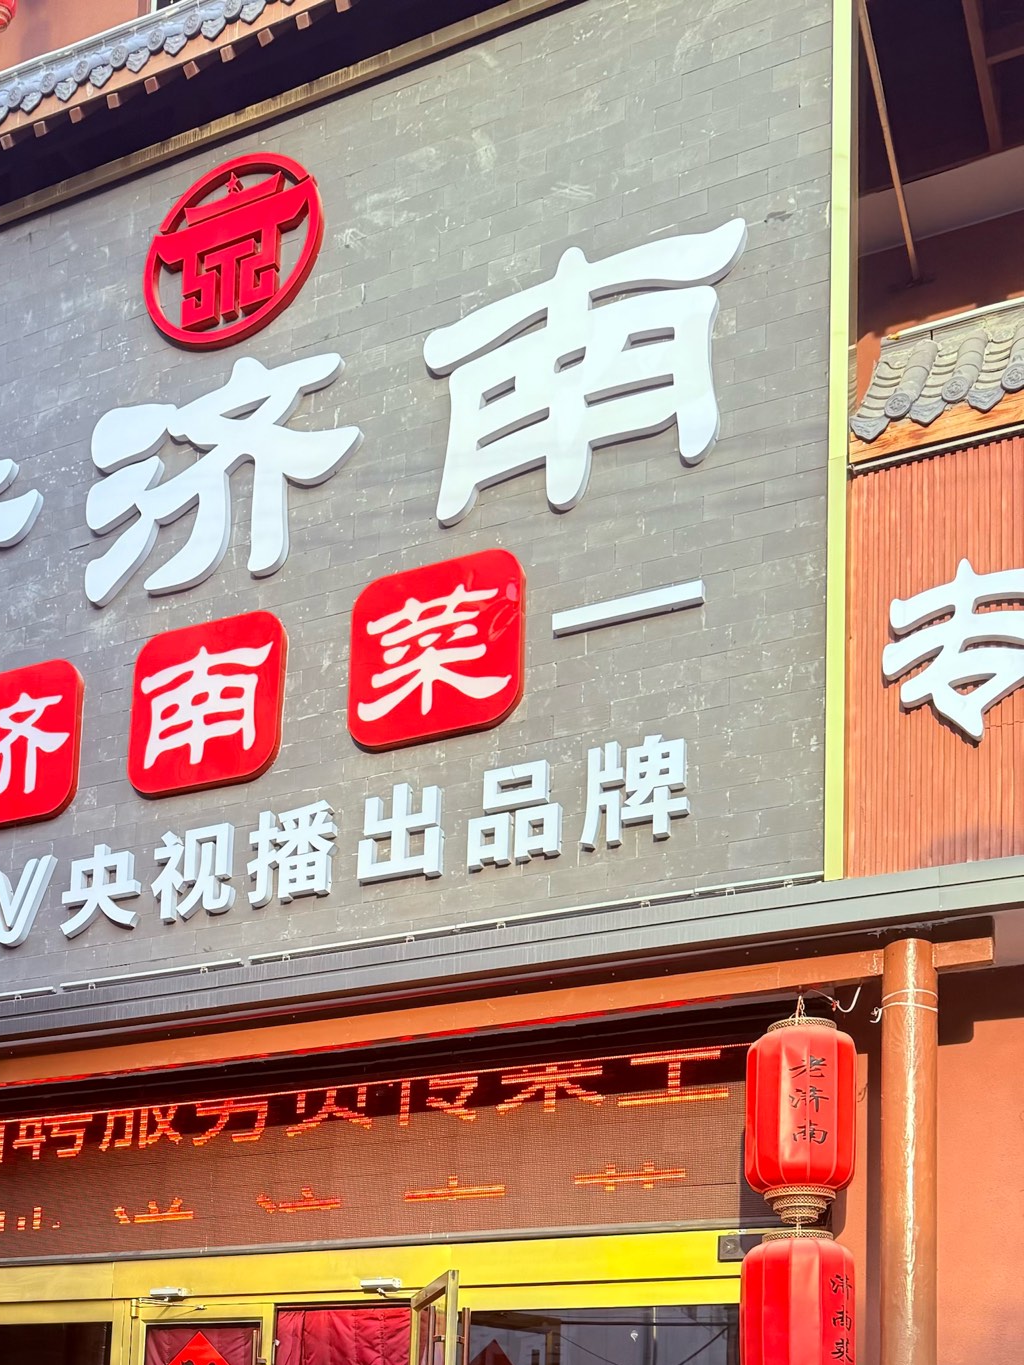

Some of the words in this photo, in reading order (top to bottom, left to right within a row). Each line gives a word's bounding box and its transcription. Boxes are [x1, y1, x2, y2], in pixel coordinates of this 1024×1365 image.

[59, 734, 691, 940] 央视播出品牌
